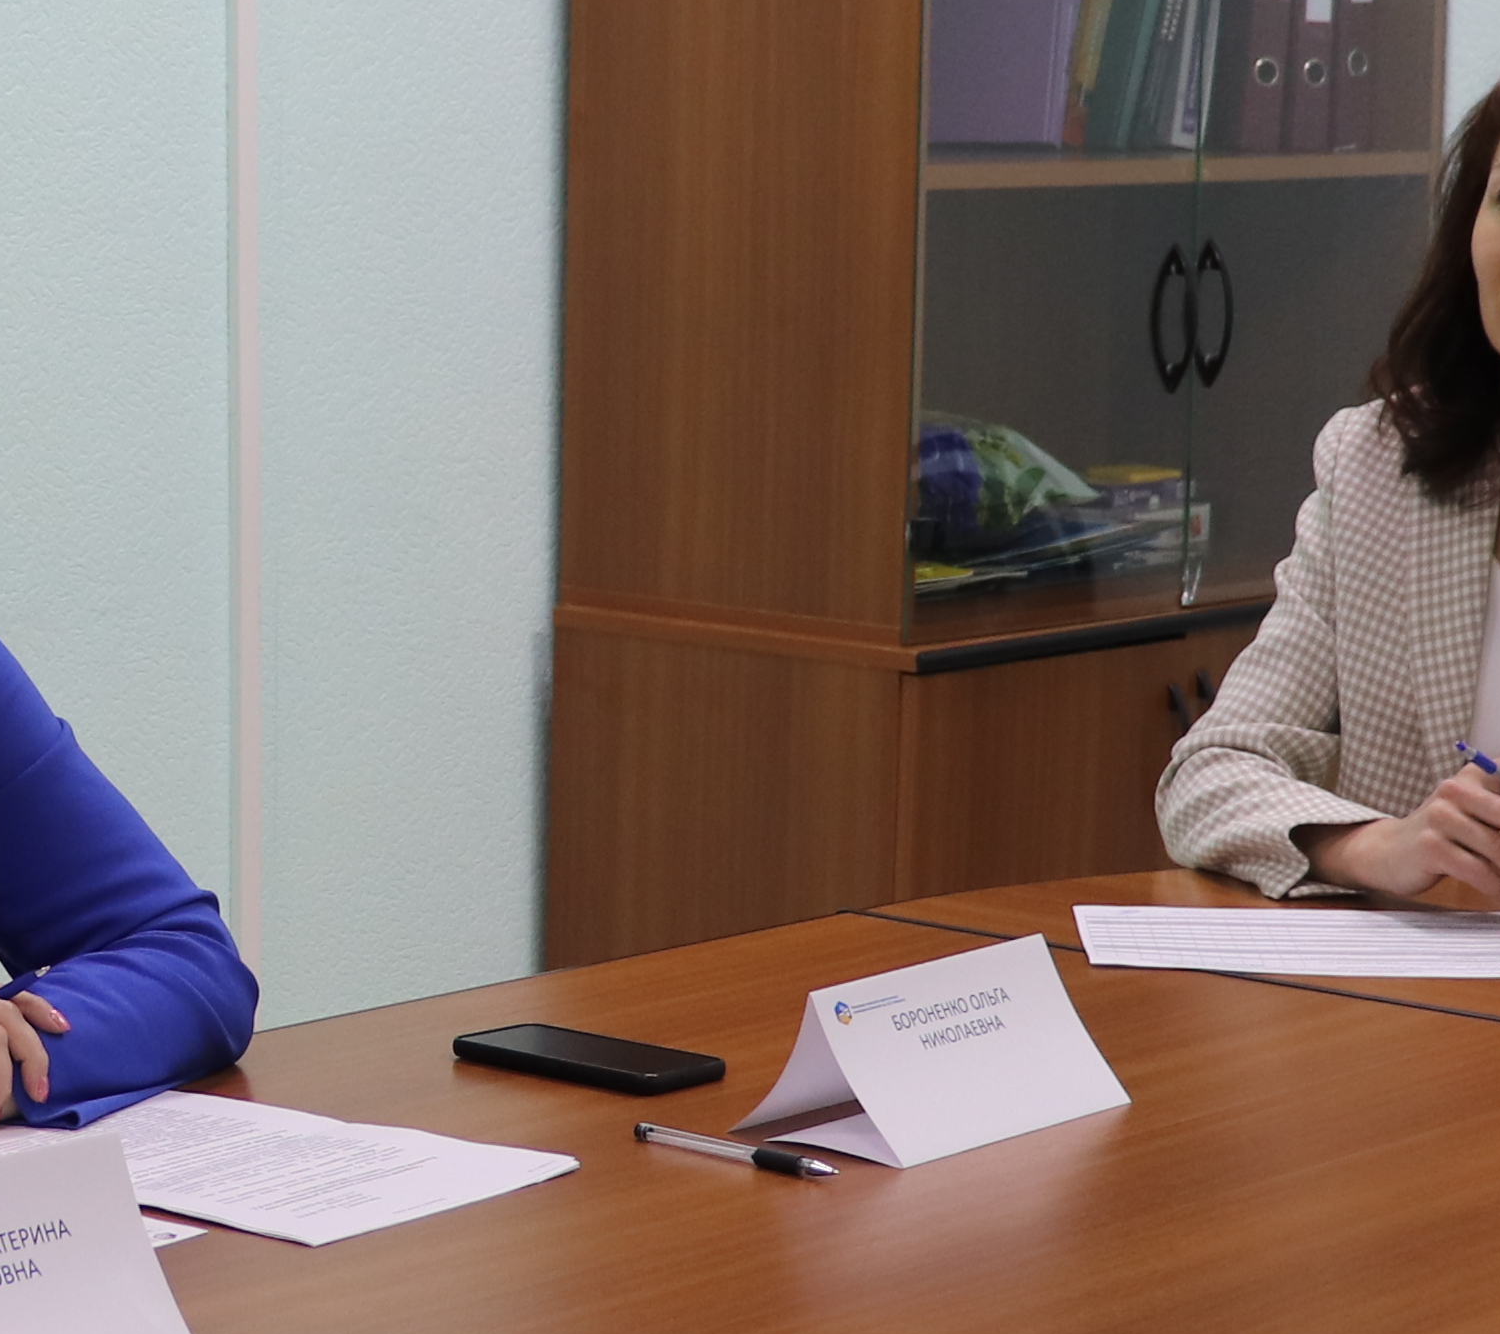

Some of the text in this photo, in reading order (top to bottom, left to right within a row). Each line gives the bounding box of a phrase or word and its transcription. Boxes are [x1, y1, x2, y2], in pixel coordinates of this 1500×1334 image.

[891, 997, 969, 1031] БОРОНЕНКО
[969, 987, 1011, 1010] ОЛЬГА
[919, 1014, 1006, 1050] НИКОЛАЕВНА
